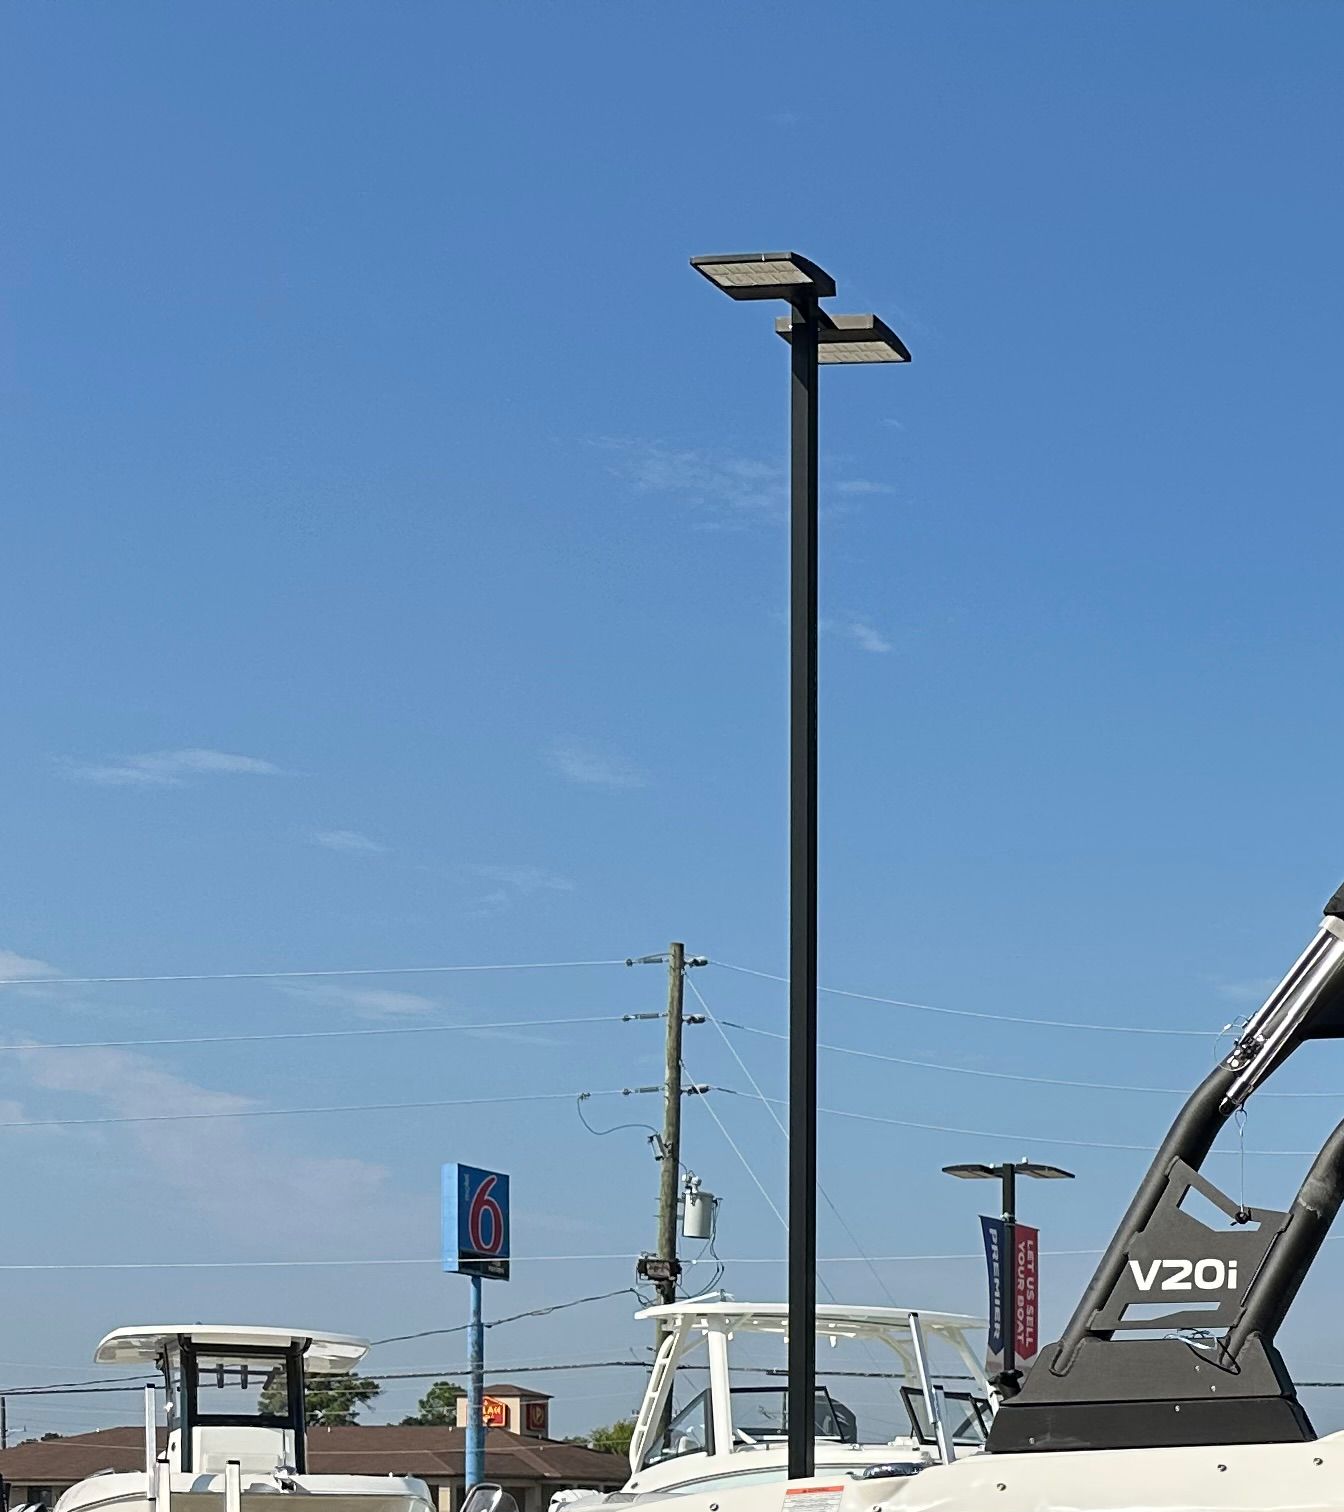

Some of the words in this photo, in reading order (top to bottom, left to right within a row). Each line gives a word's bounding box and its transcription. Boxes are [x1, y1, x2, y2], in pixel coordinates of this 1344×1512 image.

[469, 1175, 503, 1255] 6
[1017, 1241, 1026, 1291] YOUR
[1027, 1240, 1035, 1273] LET
[1128, 1258, 1238, 1291] V20i
[989, 1228, 1001, 1340] PREMIER
[1026, 1277, 1035, 1300] US
[1016, 1295, 1025, 1345] BOAT
[1026, 1304, 1035, 1348] SELL
